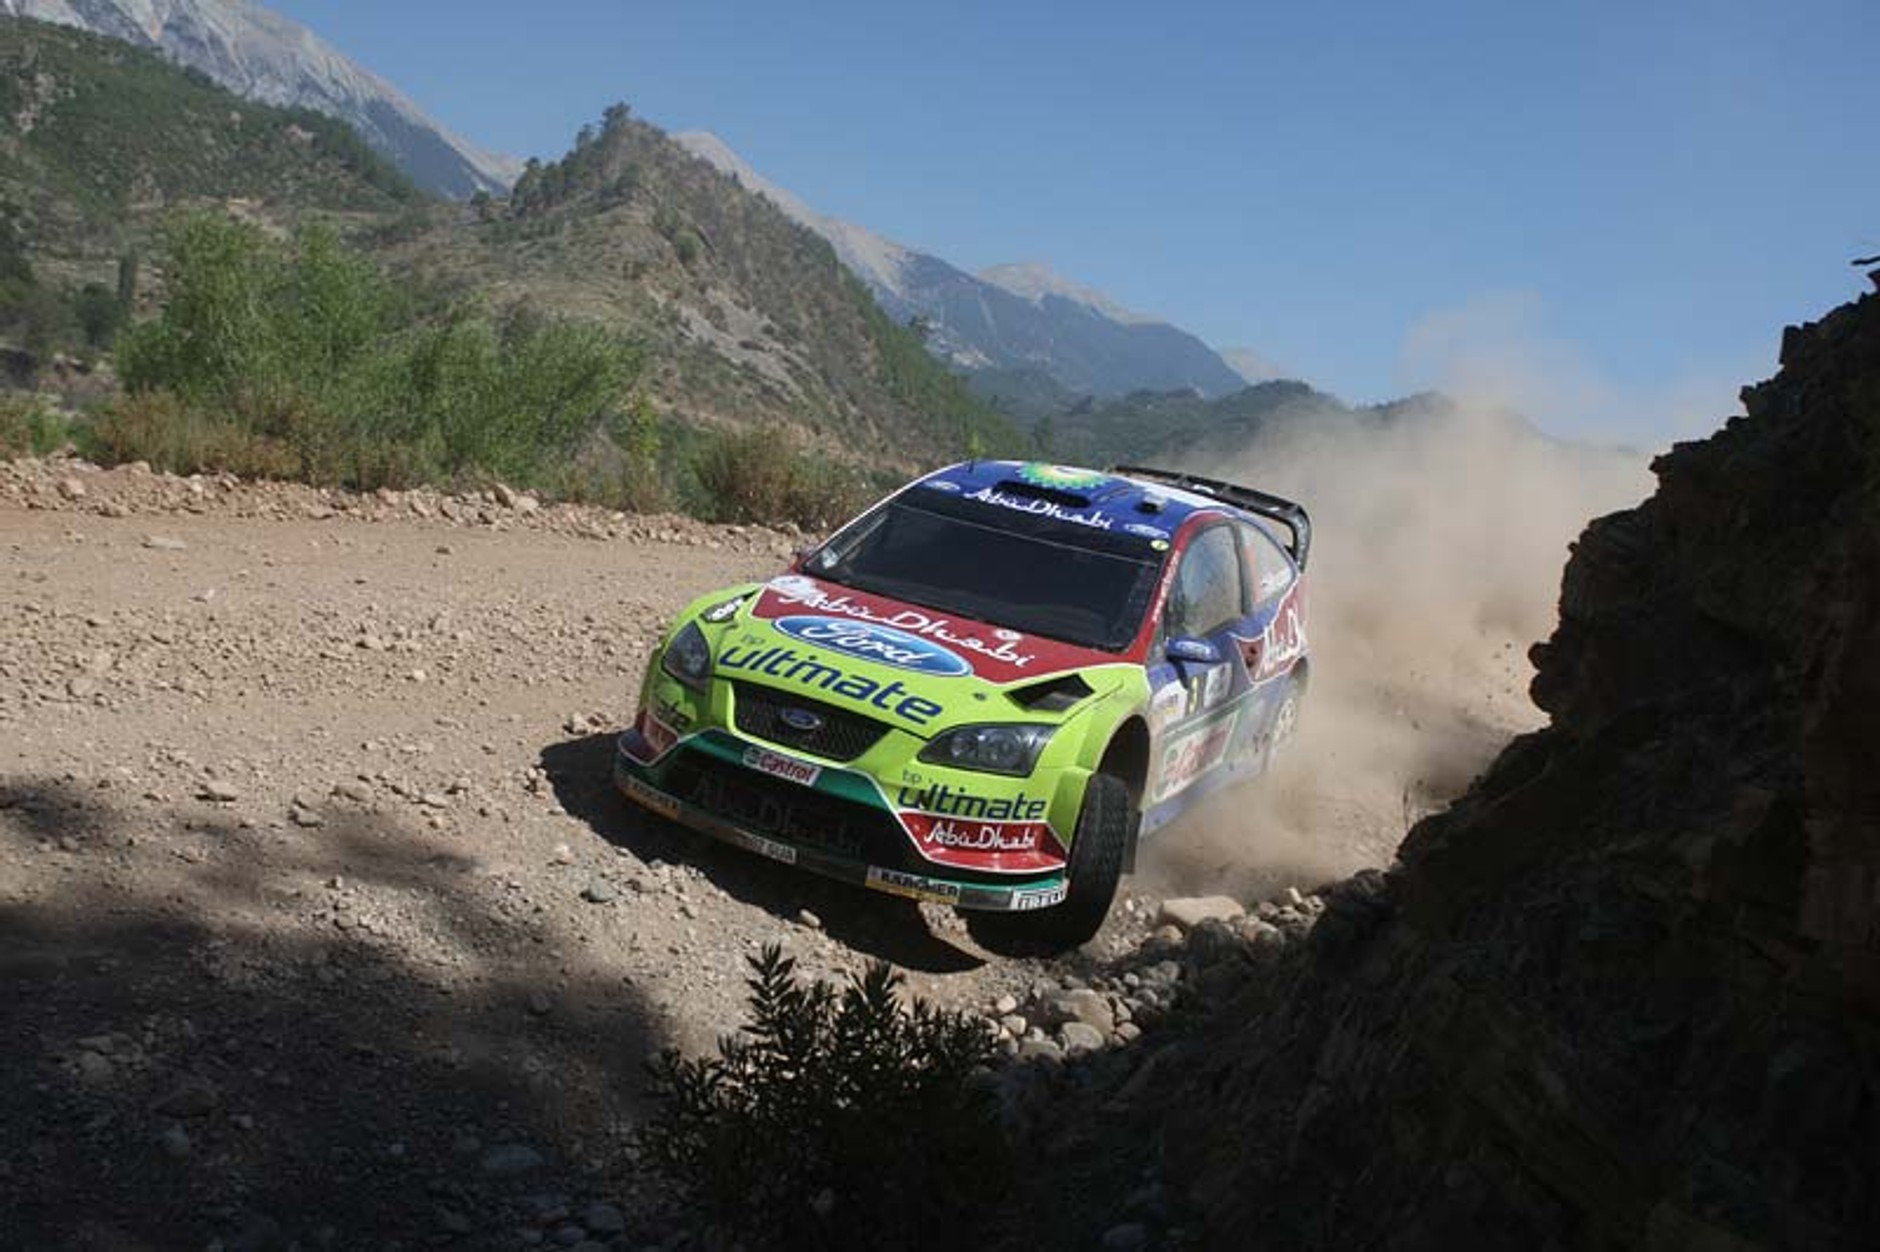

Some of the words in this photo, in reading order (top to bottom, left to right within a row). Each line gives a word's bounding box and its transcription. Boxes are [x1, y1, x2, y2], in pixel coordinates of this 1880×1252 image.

[800, 623, 933, 664] Ford
[718, 646, 943, 725] ultimate
[759, 752, 816, 783] Castrol
[898, 783, 1046, 820] ultimate
